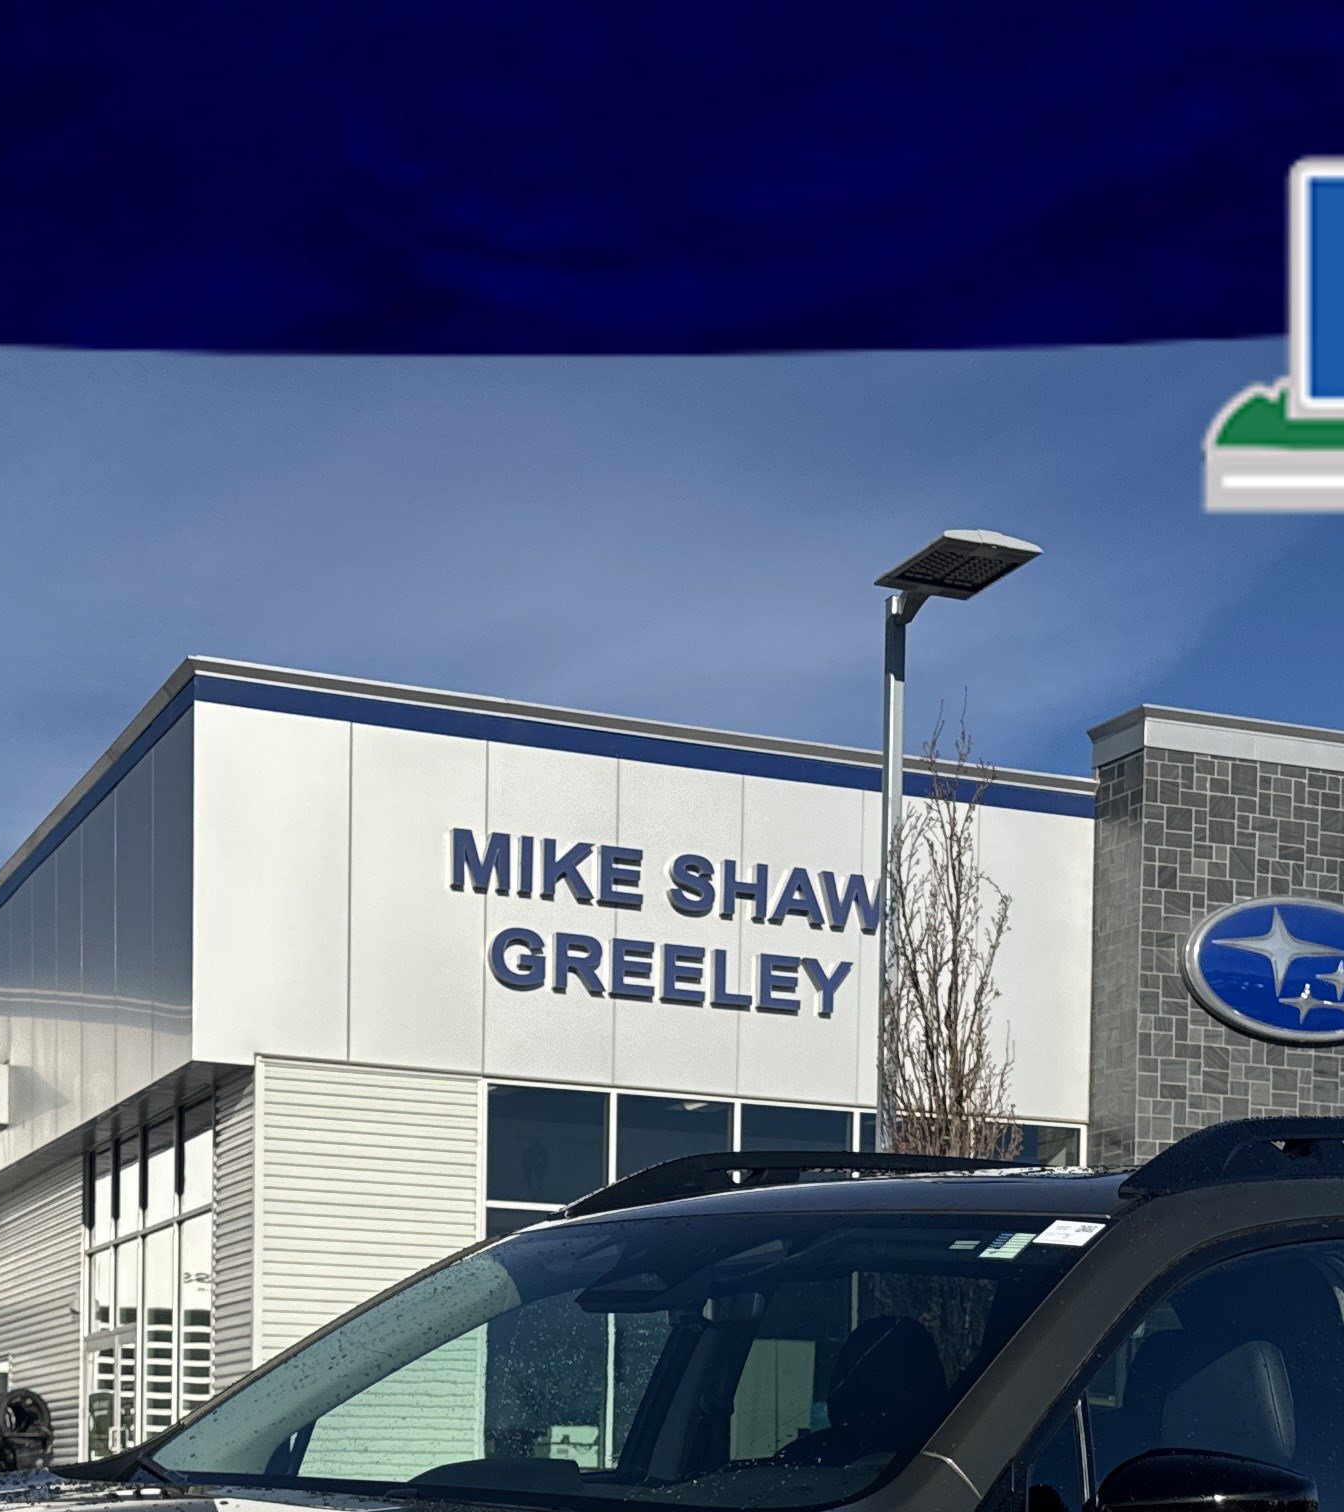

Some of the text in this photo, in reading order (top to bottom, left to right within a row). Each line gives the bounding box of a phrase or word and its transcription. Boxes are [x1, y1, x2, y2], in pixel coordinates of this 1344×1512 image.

[449, 827, 882, 935] MIKE SHAW
[487, 926, 853, 1017] GREELEY
